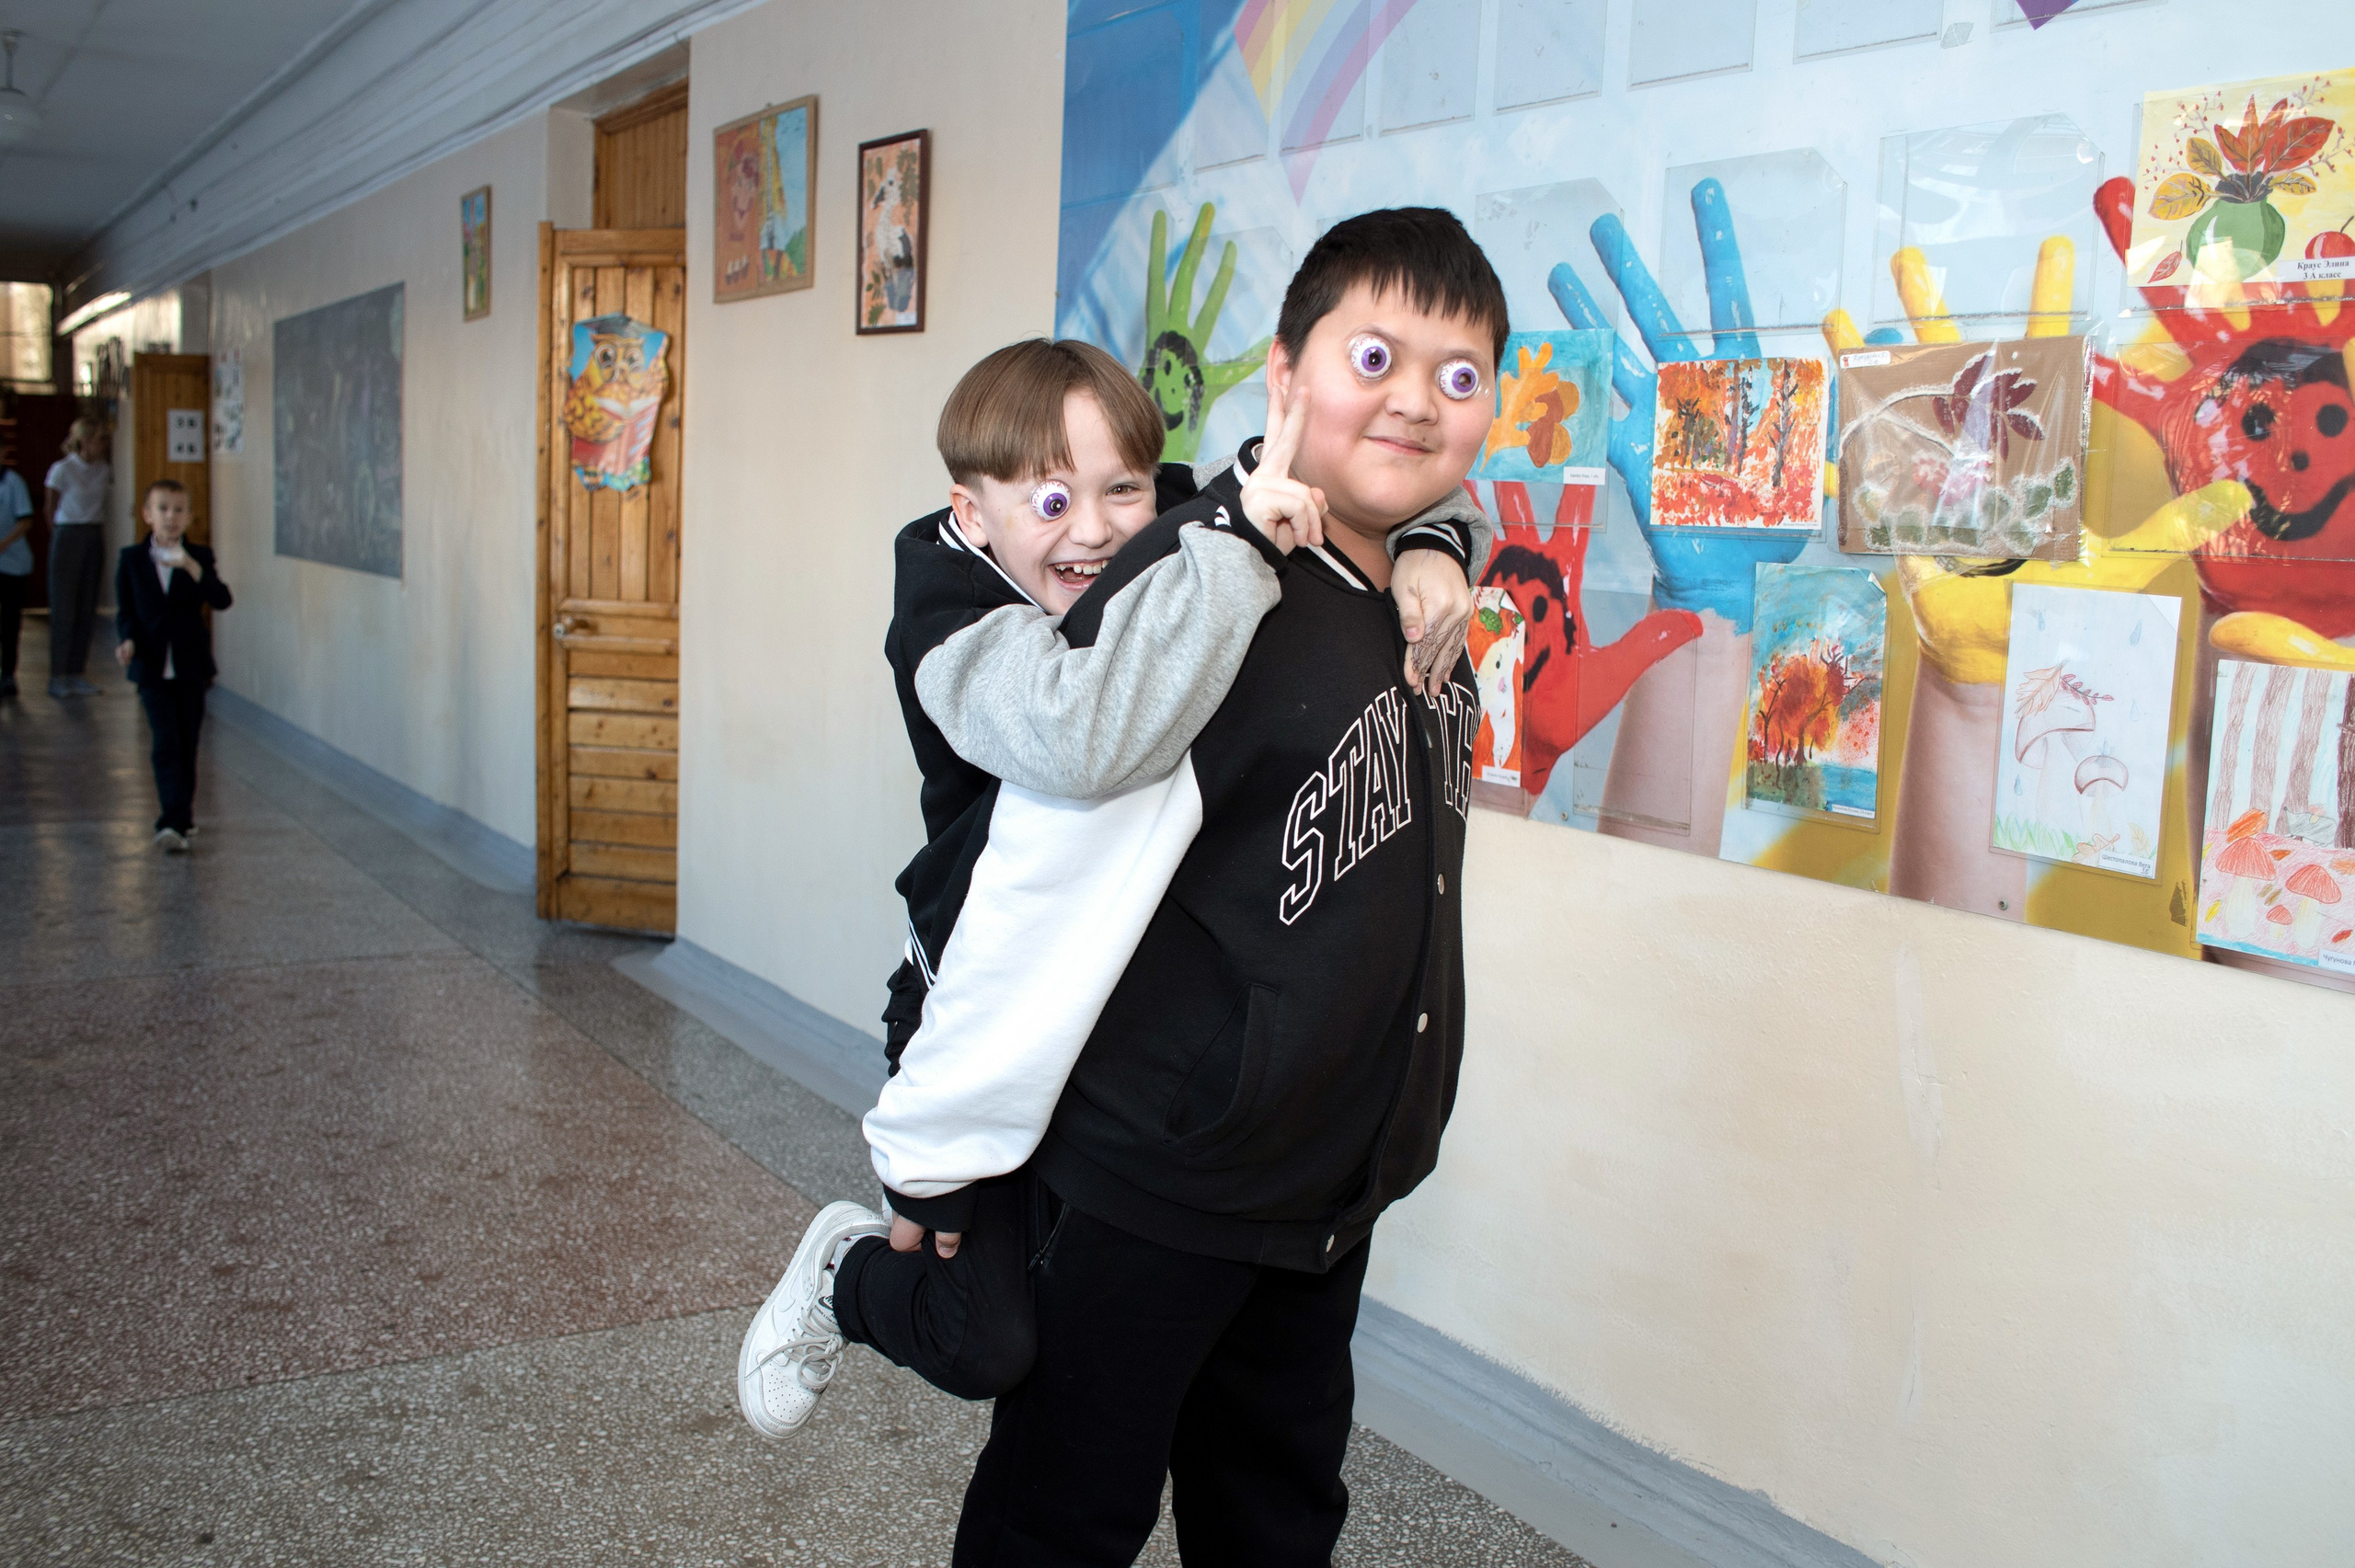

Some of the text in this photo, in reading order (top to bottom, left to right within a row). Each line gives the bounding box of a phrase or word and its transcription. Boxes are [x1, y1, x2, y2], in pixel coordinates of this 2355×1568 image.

[2297, 262, 2321, 270] Краус
[1280, 686, 1411, 925] STAY
[2101, 854, 2138, 866] Шестопалова
[2323, 954, 2352, 966] Чугунова
